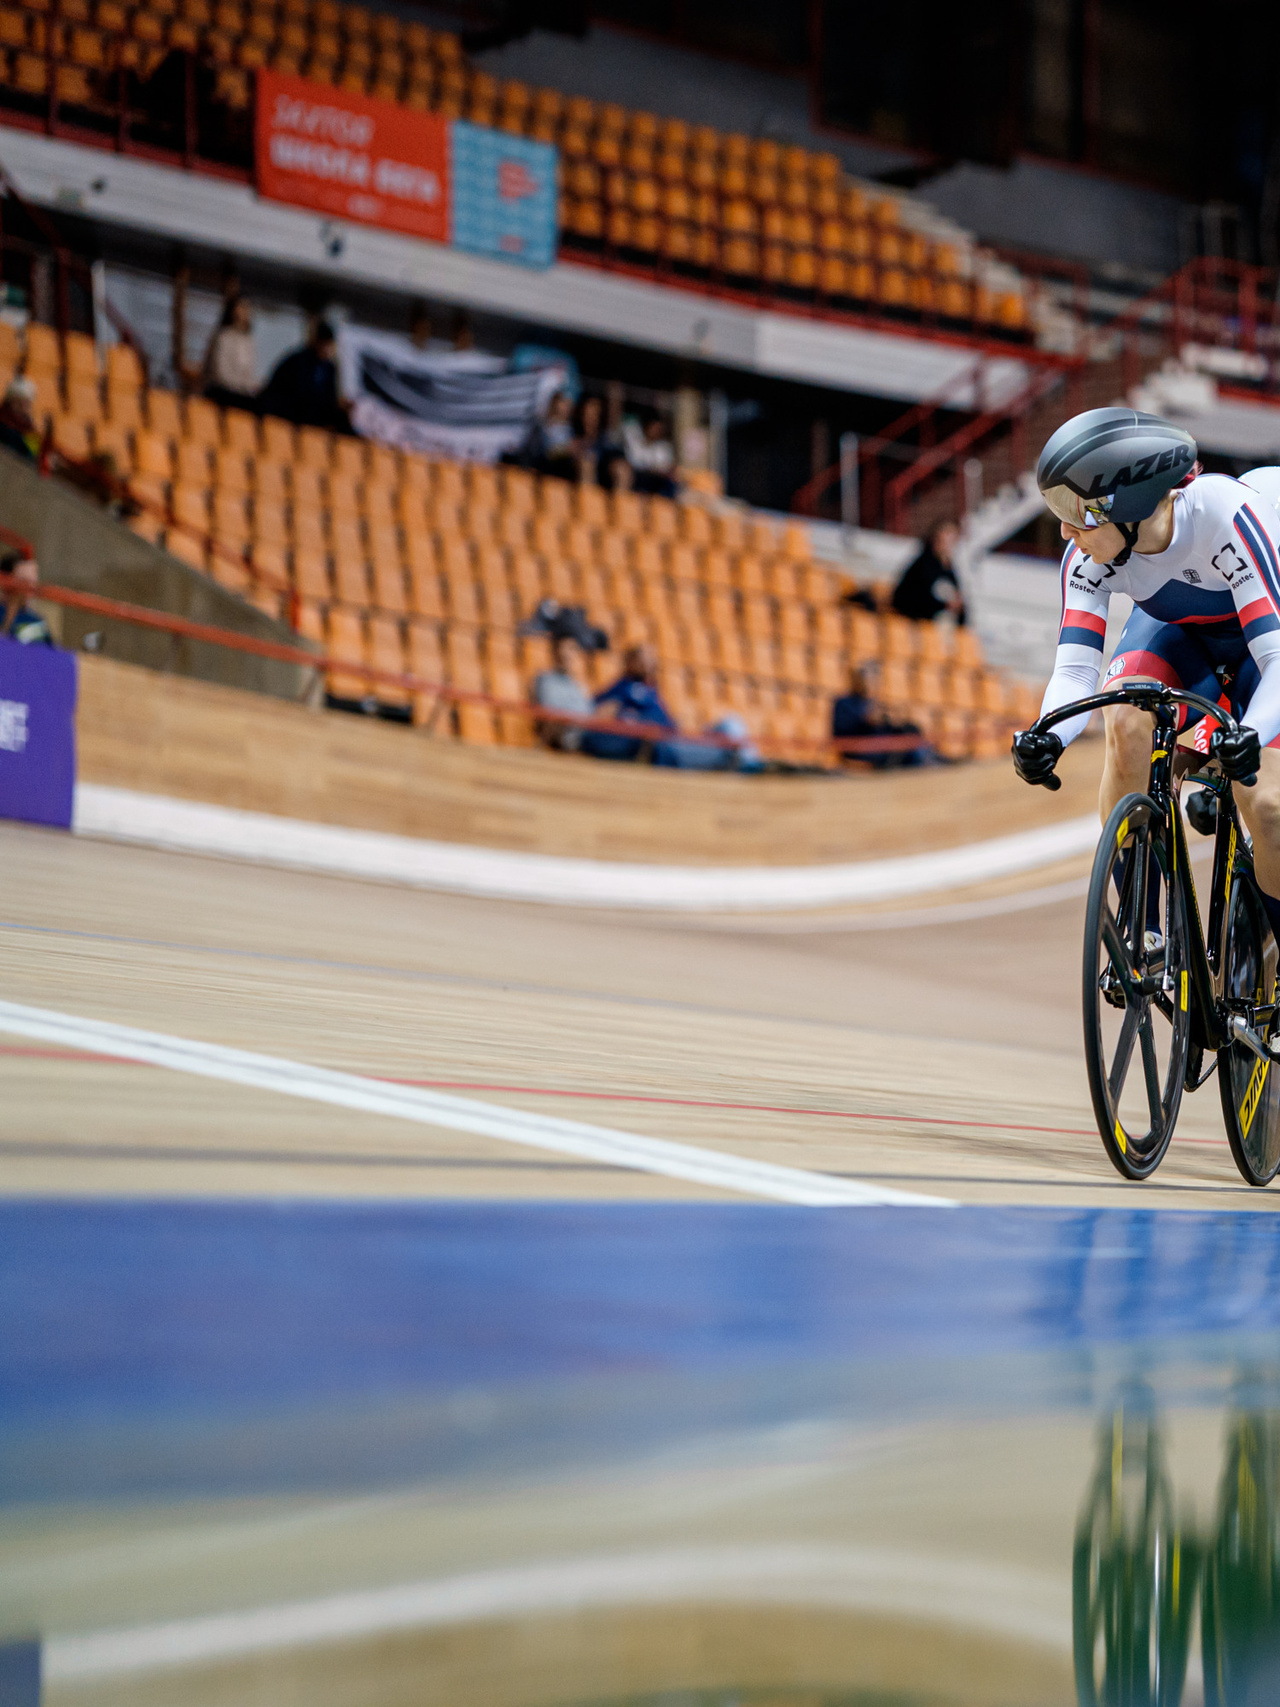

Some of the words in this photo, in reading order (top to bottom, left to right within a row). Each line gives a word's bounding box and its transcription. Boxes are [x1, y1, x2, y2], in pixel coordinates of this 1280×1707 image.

[1089, 444, 1190, 492] LAZER
[1069, 580, 1096, 595] Rostec
[1231, 572, 1255, 590] Rostec
[1244, 1060, 1268, 1126] AVIC
